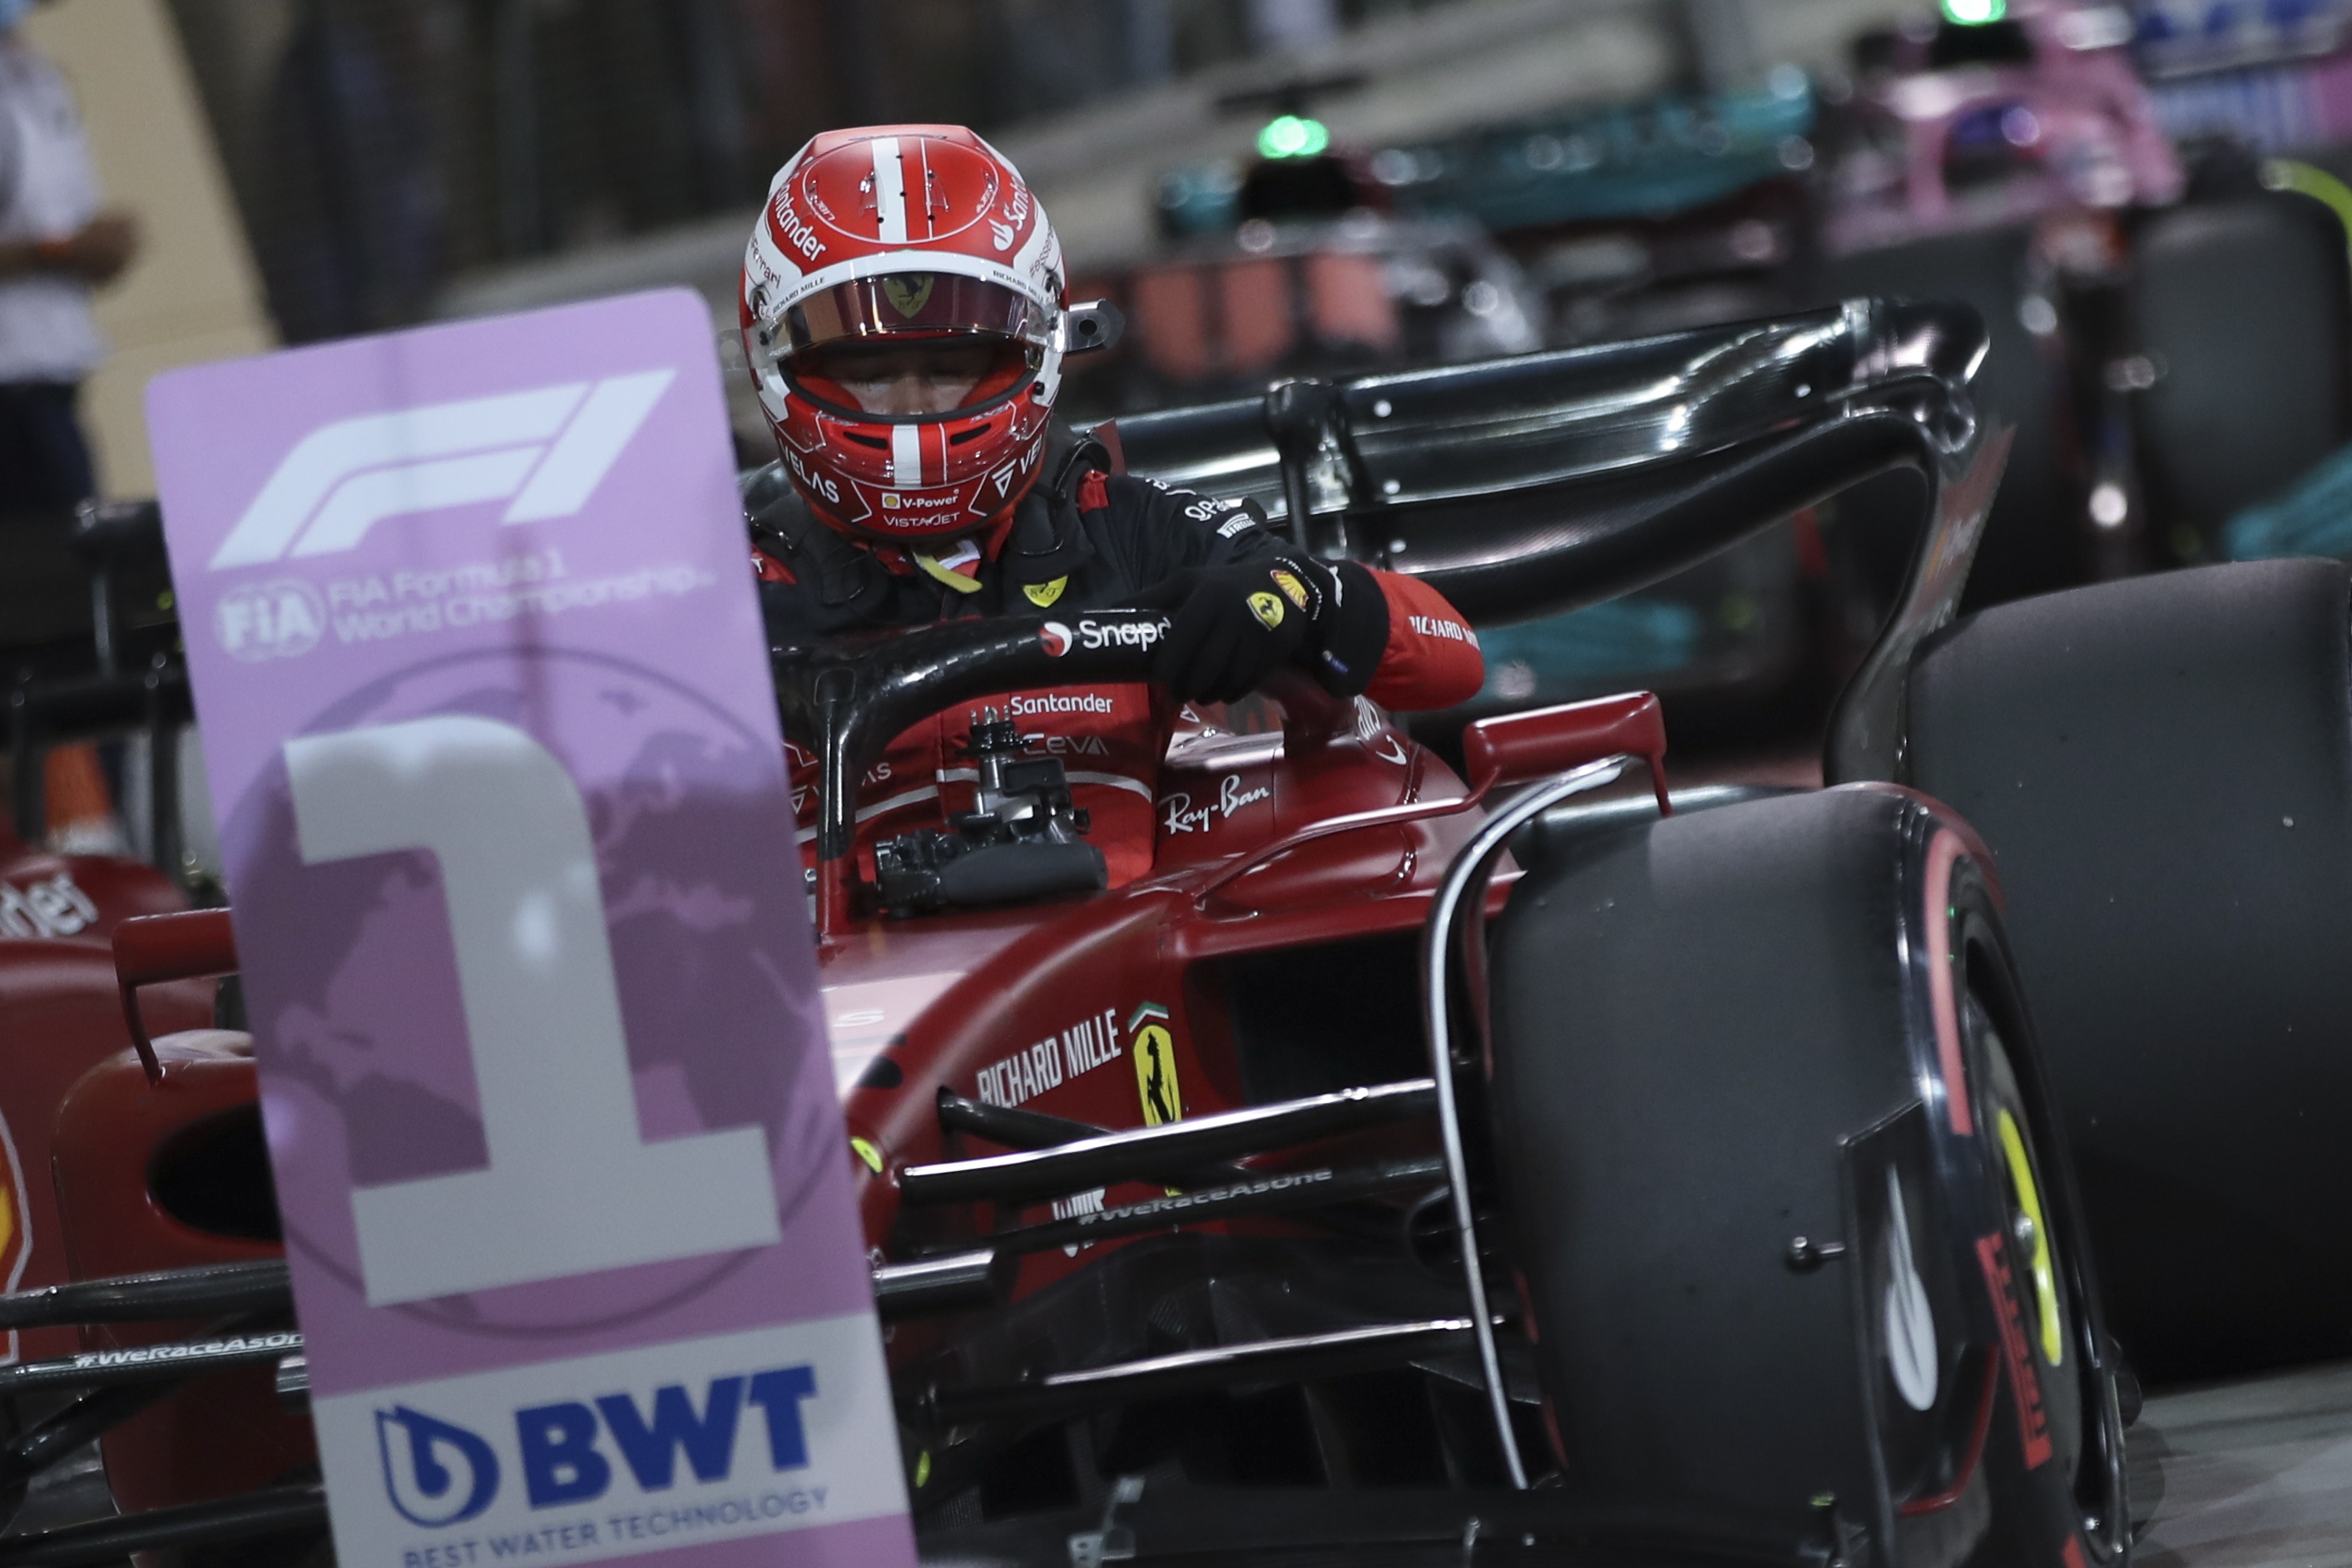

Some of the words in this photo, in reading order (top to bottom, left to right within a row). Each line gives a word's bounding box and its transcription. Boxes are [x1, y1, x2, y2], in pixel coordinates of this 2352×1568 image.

[800, 277, 826, 294] MILLE
[208, 368, 678, 571] F1
[902, 495, 958, 509] V-Power
[334, 600, 442, 644] World
[1011, 693, 1113, 715] Santander
[1157, 774, 1270, 835] Ray-Ban
[283, 714, 784, 1309] 1
[977, 1036, 1063, 1110] RICHARD
[1062, 1007, 1122, 1080] MILLE
[1078, 1168, 1333, 1226] #WeRaceAsOne
[73, 1332, 306, 1368] #WeRaceAsOn
[512, 1365, 819, 1511] BWT
[404, 1541, 478, 1568] BEST
[488, 1522, 600, 1559] WATER
[608, 1486, 829, 1540] TECHNOLOGY
